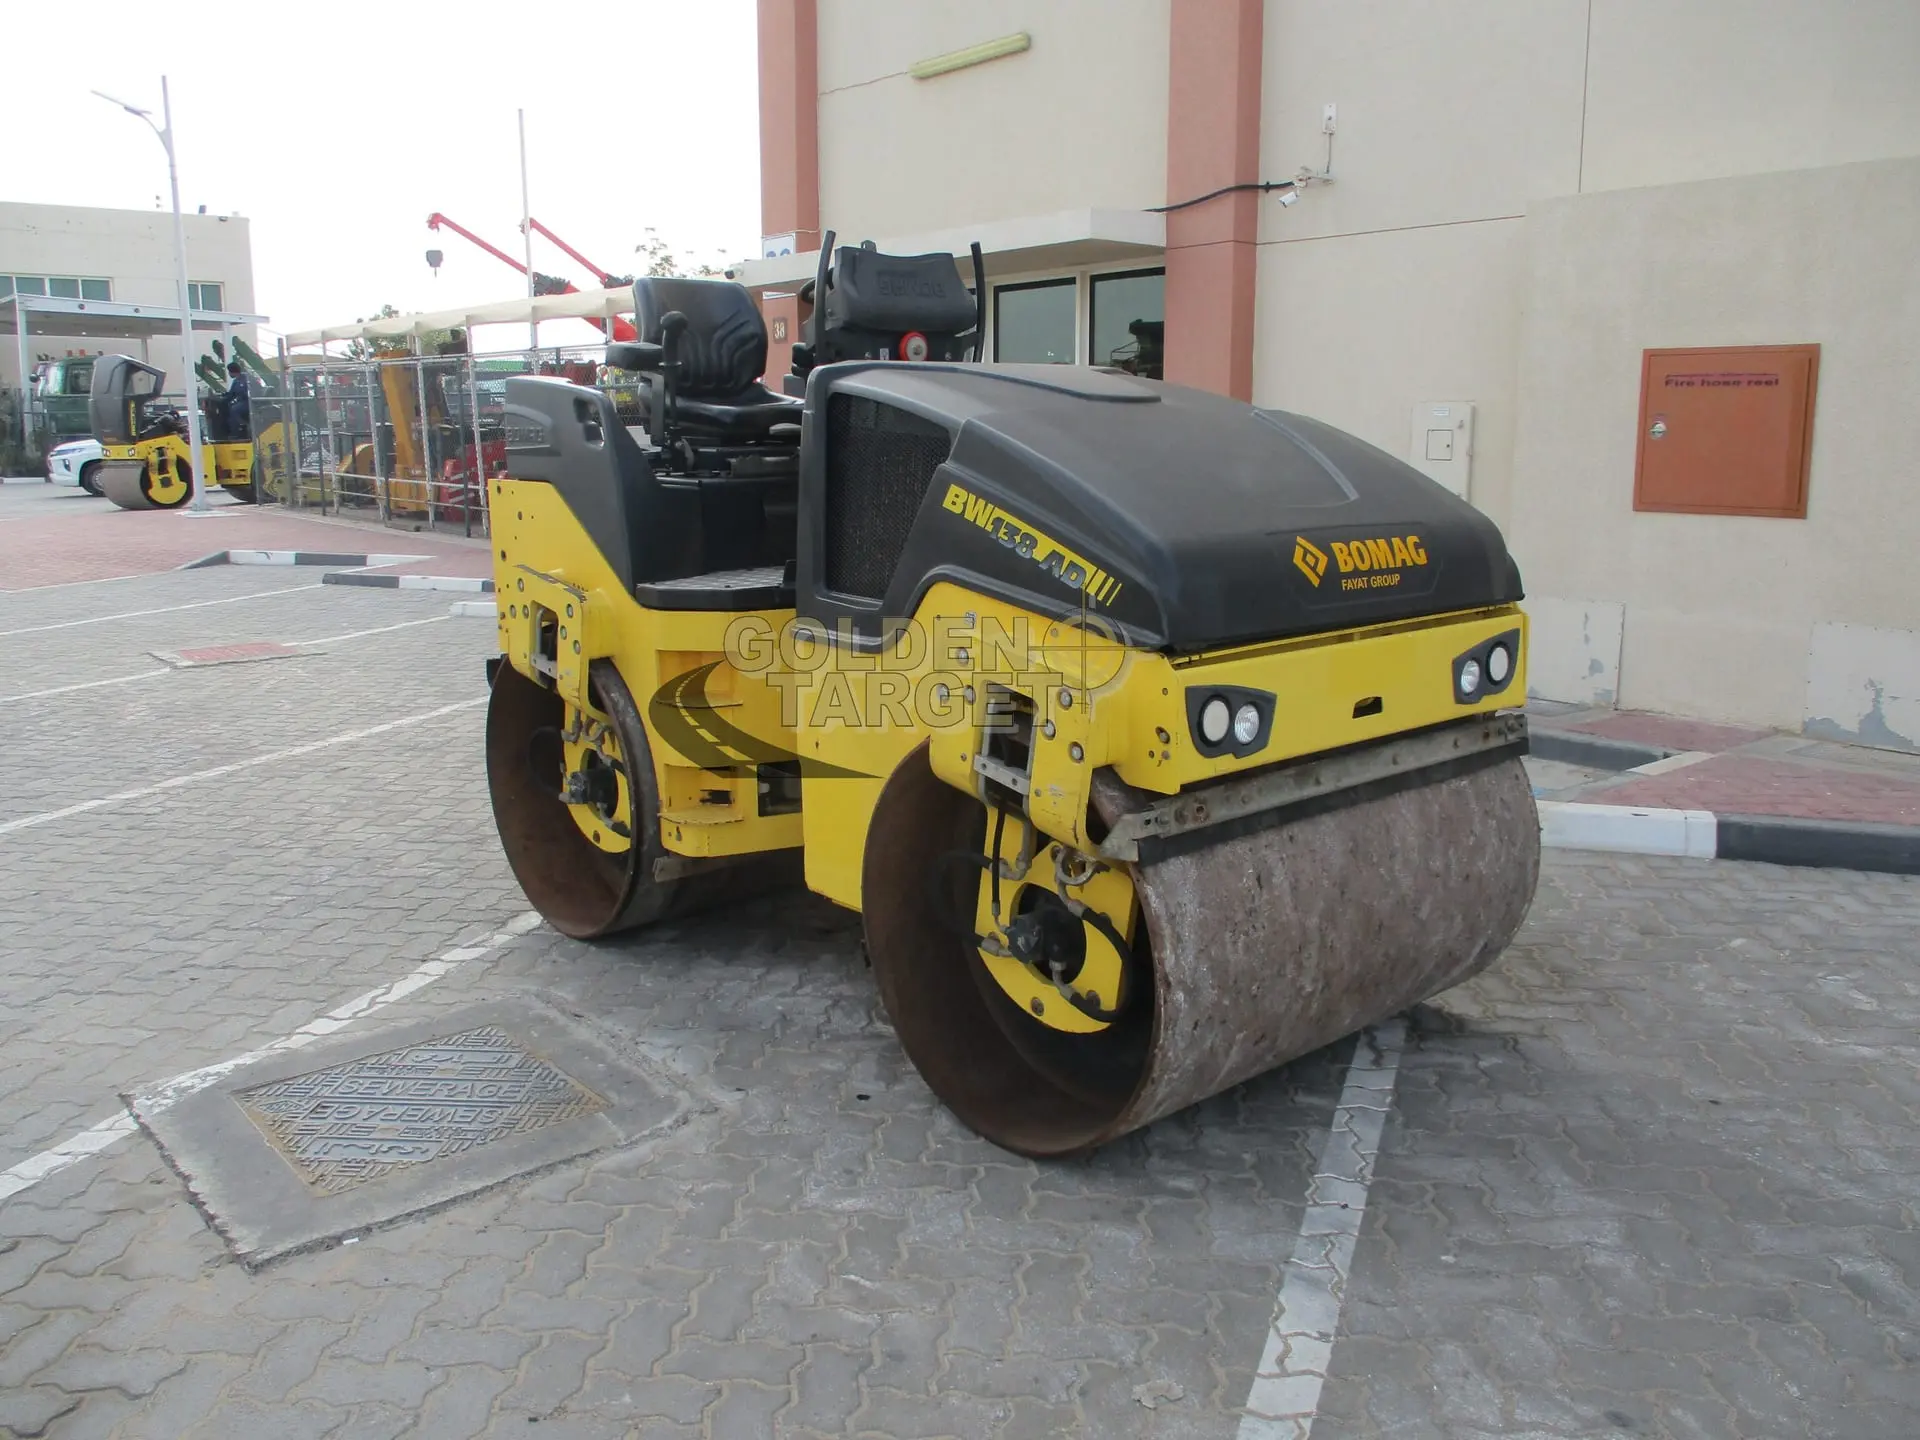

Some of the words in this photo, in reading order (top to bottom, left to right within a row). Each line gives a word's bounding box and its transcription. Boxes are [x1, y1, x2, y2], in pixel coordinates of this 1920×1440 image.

[774, 322, 785, 339] 38
[1665, 379, 1695, 387] Fire
[1747, 378, 1779, 387] reel
[942, 484, 1038, 558] BW138
[1037, 549, 1087, 589] AD
[1330, 535, 1428, 573] BOMAG
[1341, 577, 1368, 590] FAYAT
[1370, 573, 1400, 588] GROUP
[338, 1079, 526, 1099] SEWERAGE
[308, 1103, 503, 1124] SEWERAGE
